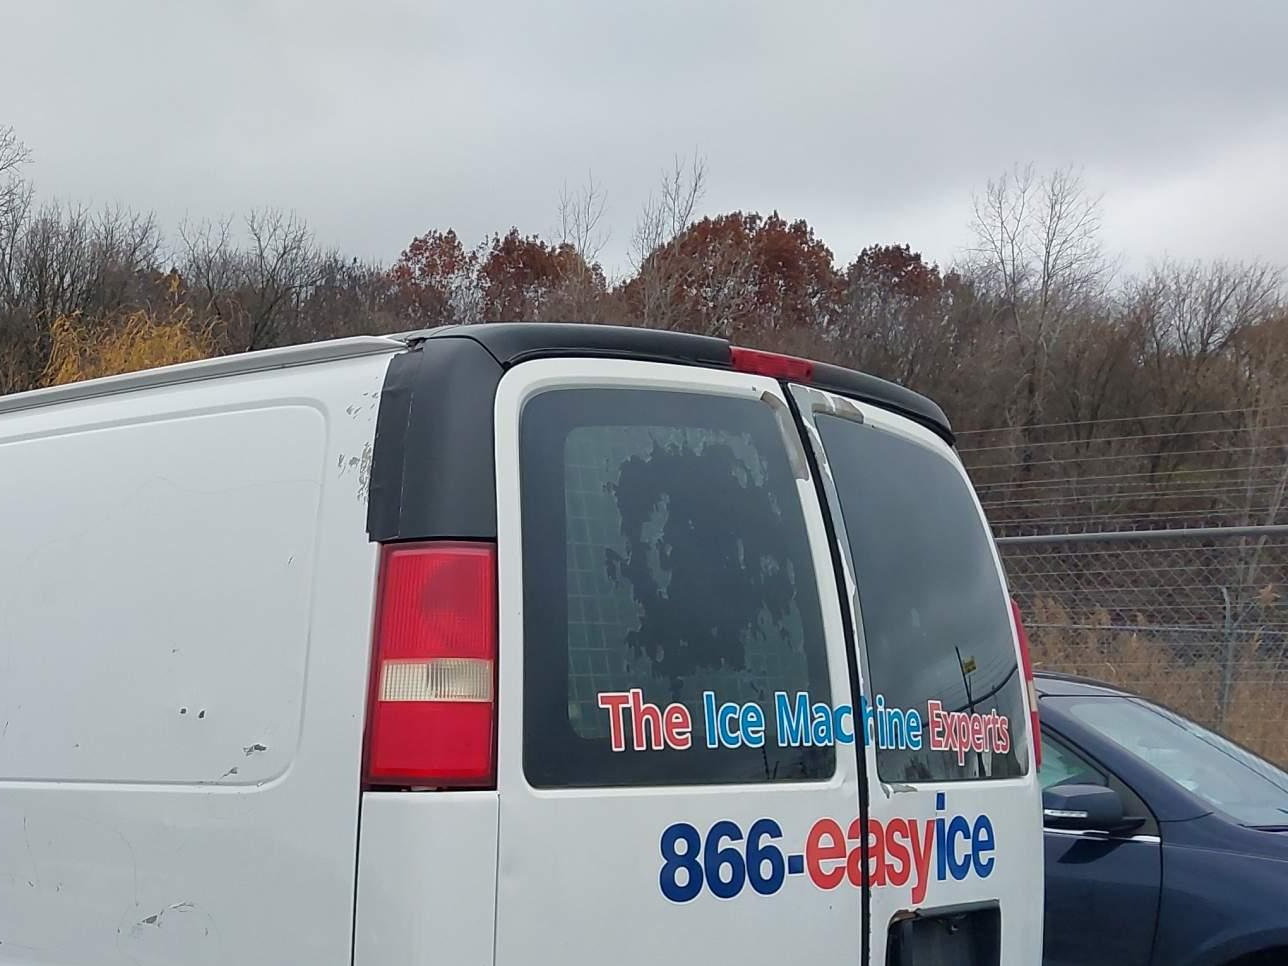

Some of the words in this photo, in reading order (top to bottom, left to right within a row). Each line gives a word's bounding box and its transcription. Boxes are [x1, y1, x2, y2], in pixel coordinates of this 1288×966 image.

[600, 690, 691, 752] The
[703, 691, 765, 750] Ice
[774, 690, 922, 751] Machine
[928, 700, 1010, 766] Experts
[659, 792, 996, 904] 866-easyice
